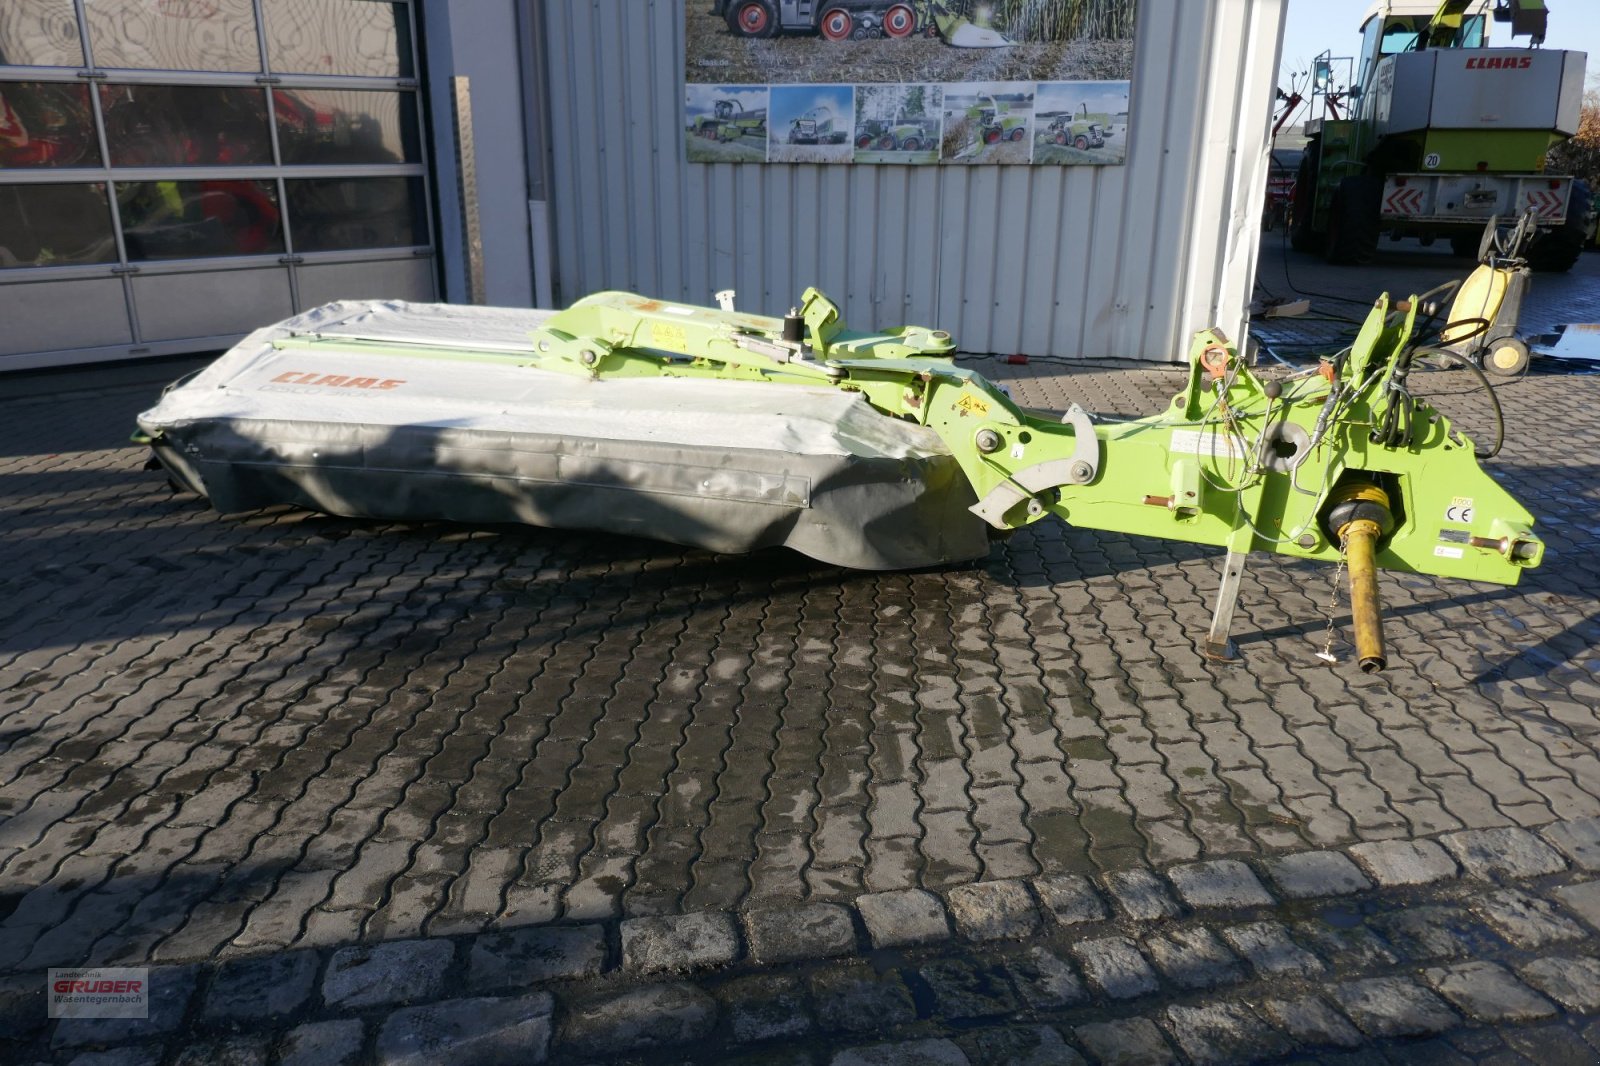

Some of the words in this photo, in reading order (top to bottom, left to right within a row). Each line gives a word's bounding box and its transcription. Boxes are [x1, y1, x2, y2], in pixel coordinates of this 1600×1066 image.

[698, 58, 729, 66] claas.de
[1465, 57, 1531, 69] CLAAS
[1427, 155, 1438, 166] 20
[270, 372, 407, 390] CLAAS
[1447, 506, 1471, 522] CE
